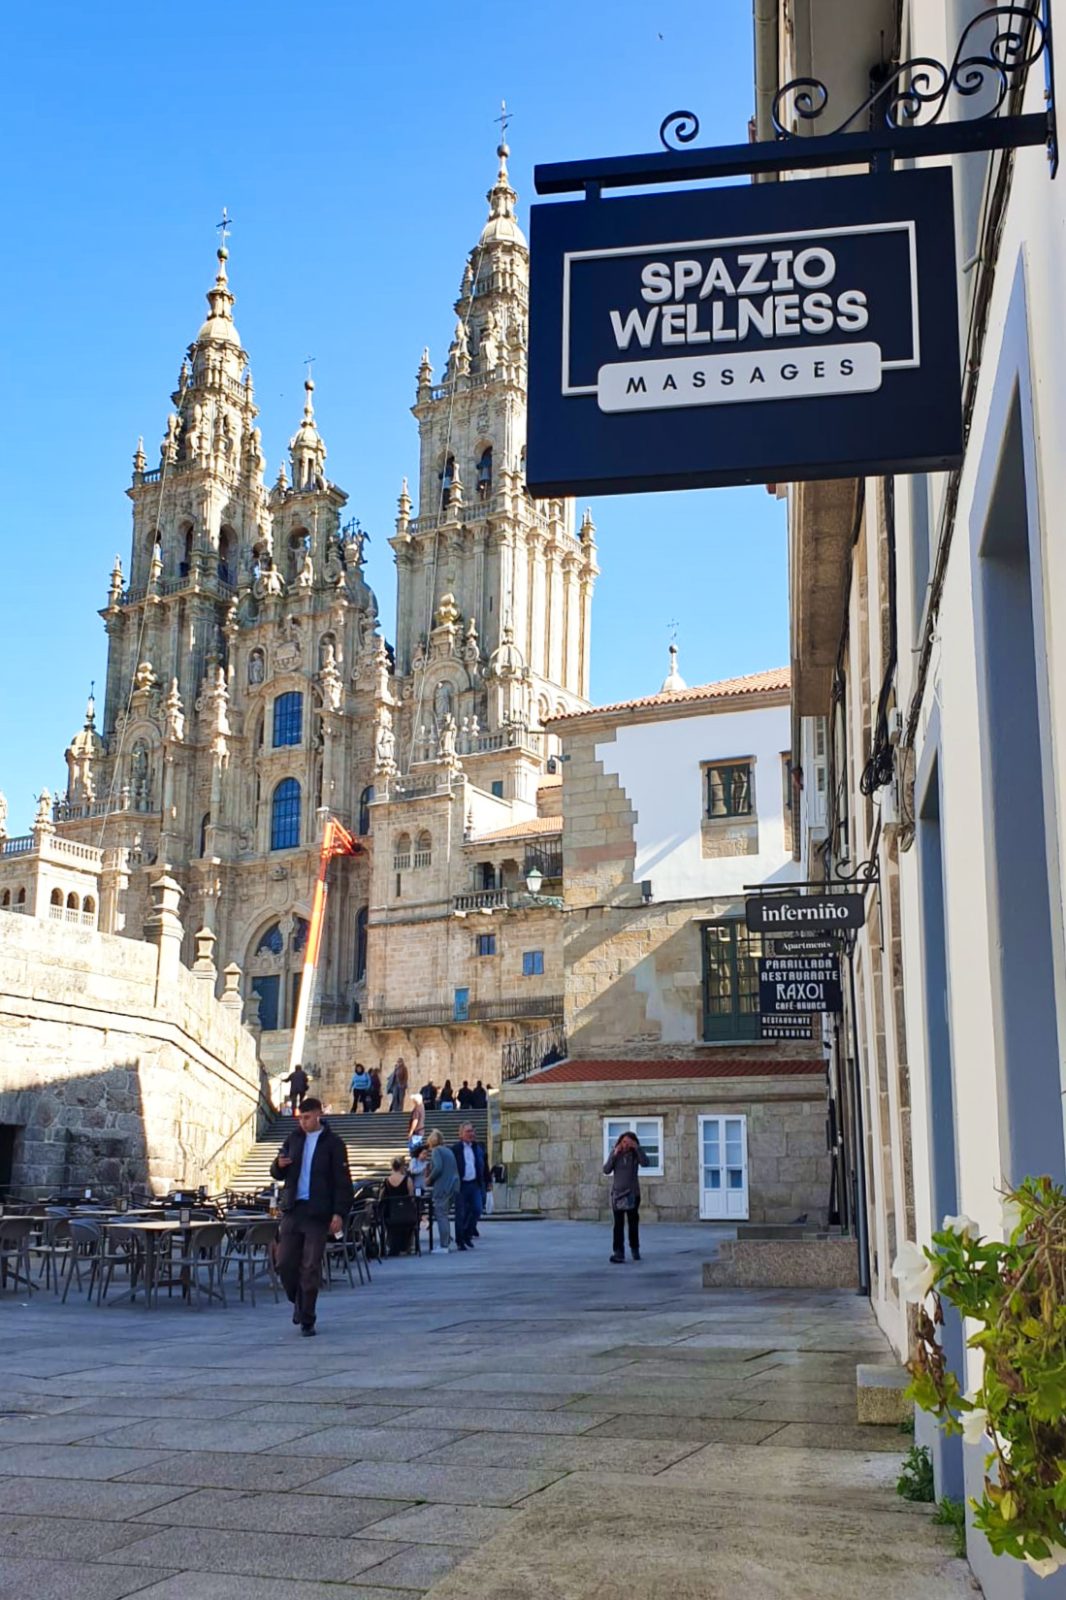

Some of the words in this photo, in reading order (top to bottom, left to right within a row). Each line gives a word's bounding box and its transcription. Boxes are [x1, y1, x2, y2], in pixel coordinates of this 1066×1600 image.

[640, 246, 837, 304] SPAZIO
[609, 289, 870, 351] WELLNESS
[625, 358, 855, 395] MASSAGES
[762, 903, 849, 922] inferniño
[783, 941, 831, 951] Apartments
[765, 959, 833, 970] PARRILLADA
[761, 970, 839, 981] RESTAURANTE
[776, 983, 824, 1000] RAXOI
